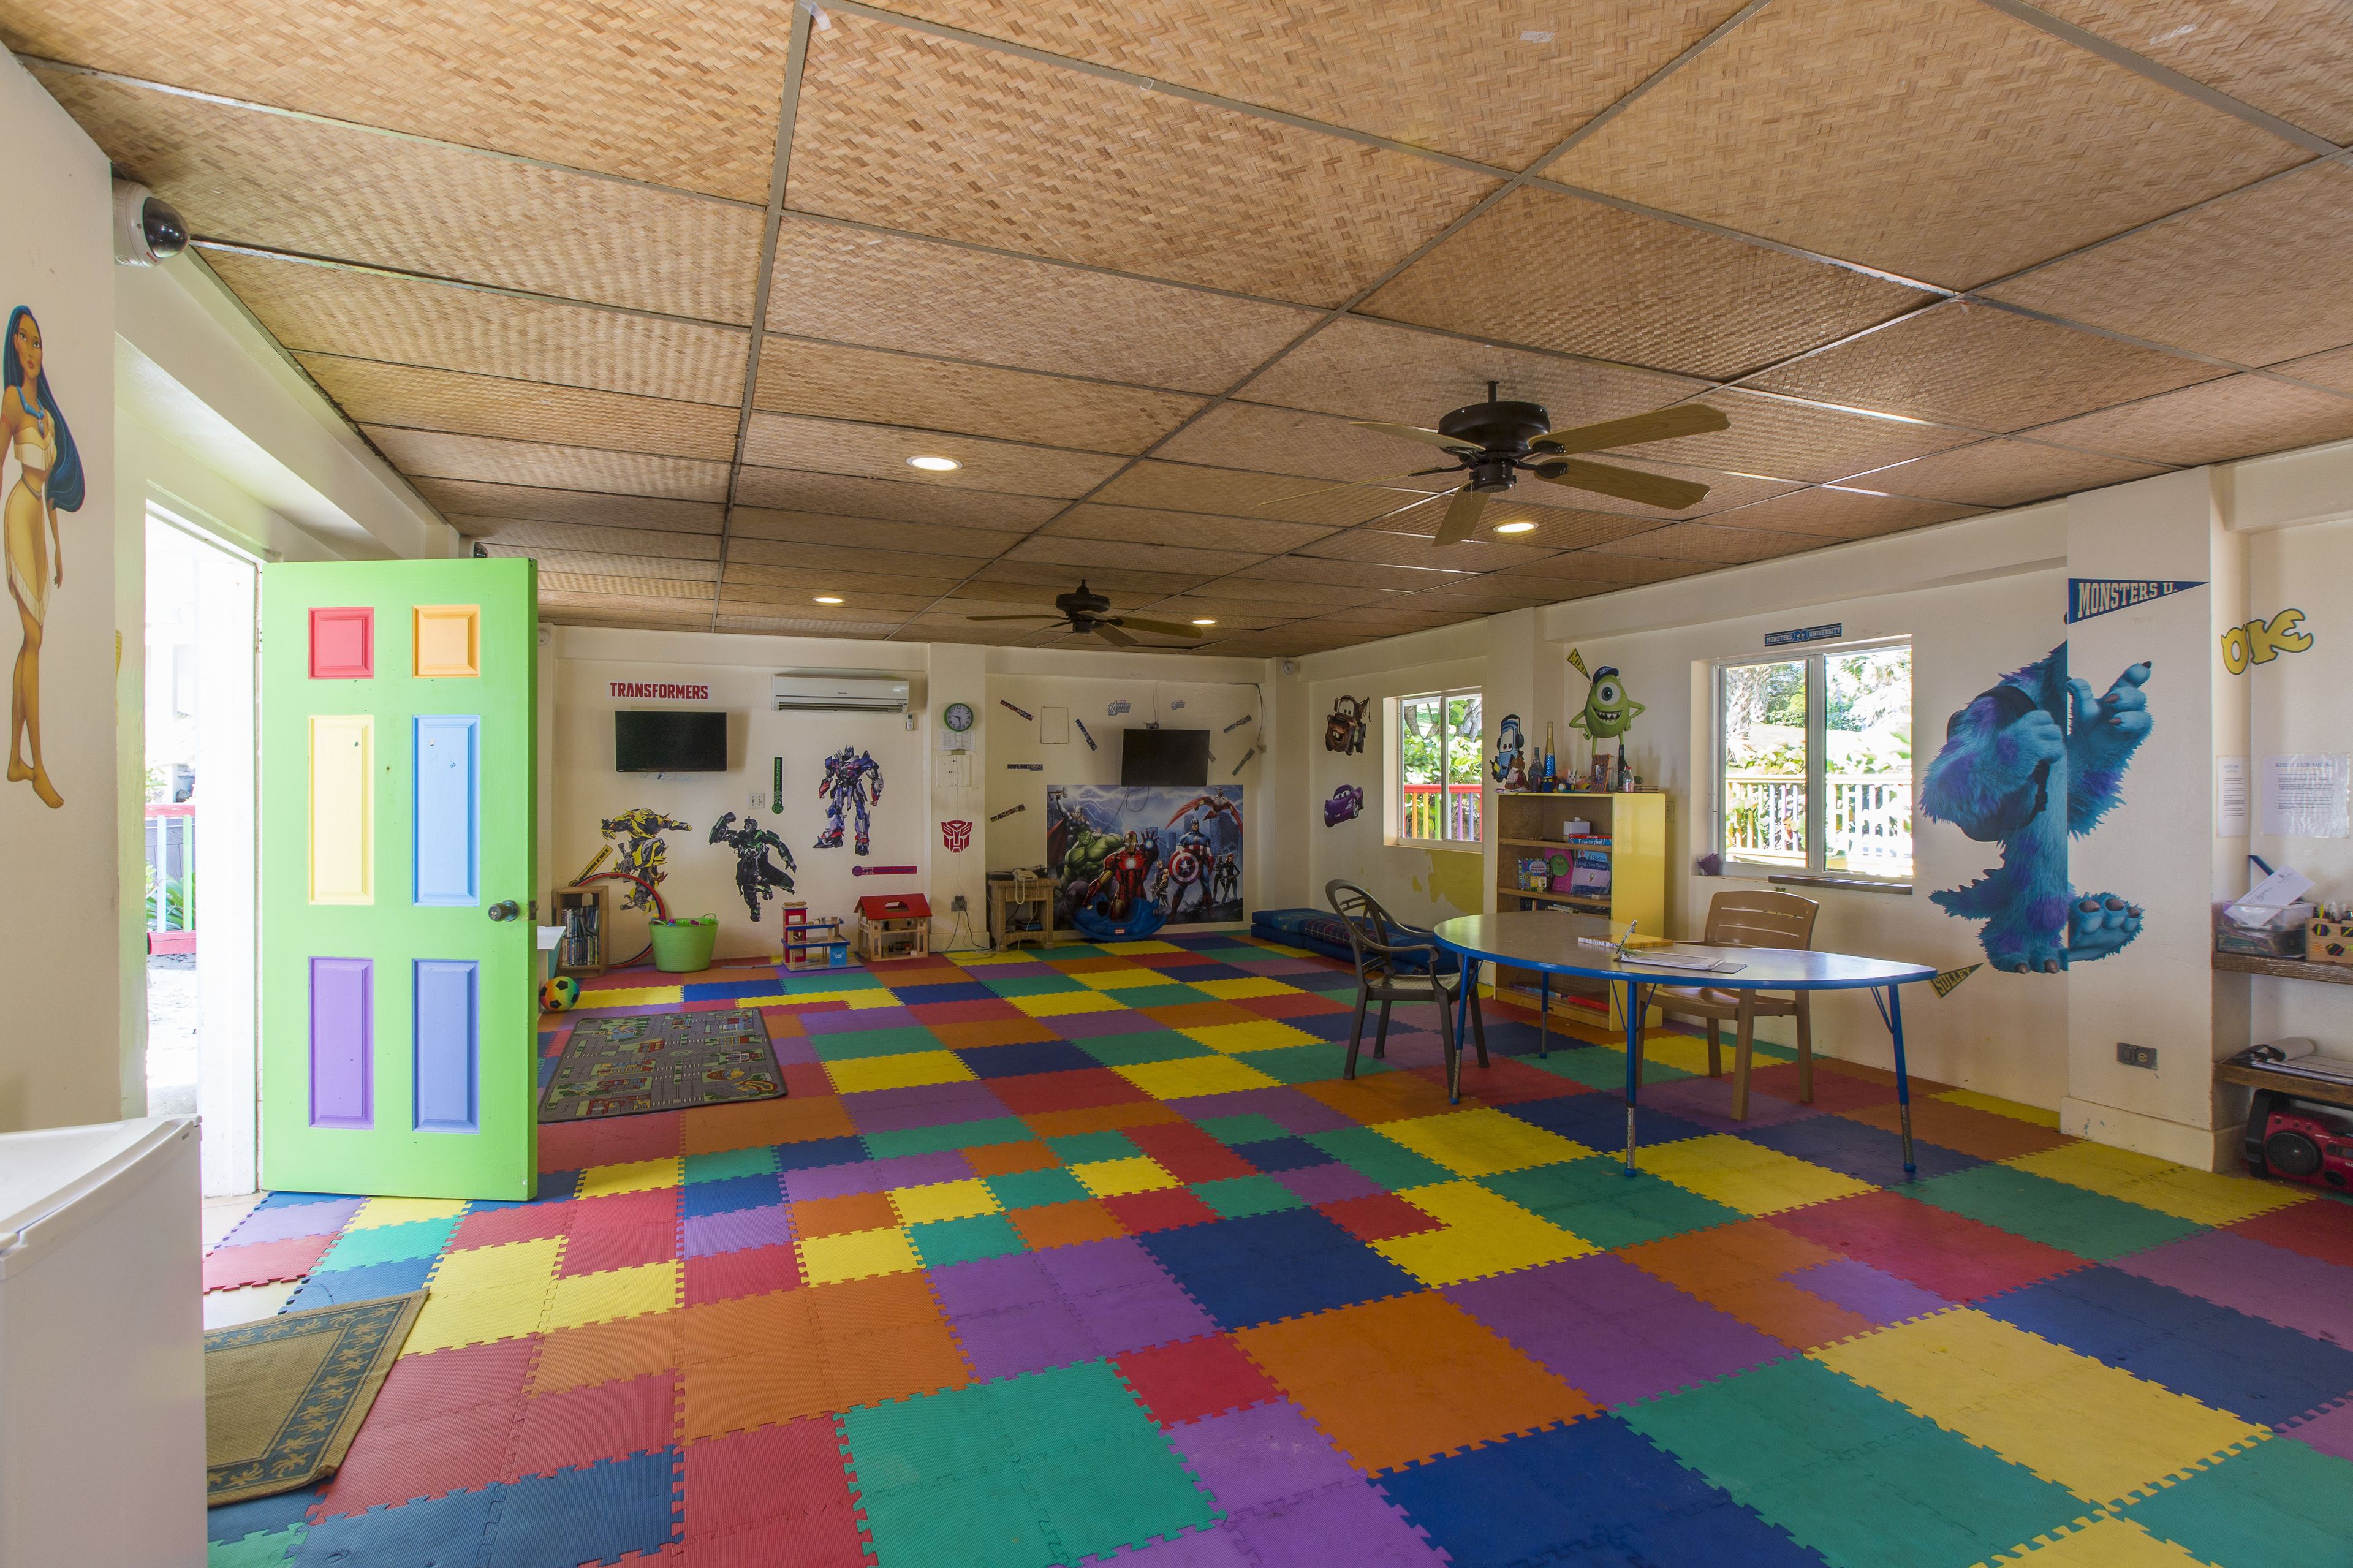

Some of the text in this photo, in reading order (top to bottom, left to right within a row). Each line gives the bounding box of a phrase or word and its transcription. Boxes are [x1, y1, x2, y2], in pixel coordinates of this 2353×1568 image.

[2077, 583, 2177, 618] MONSTERS U.
[1766, 634, 1792, 643] MONSTERS
[1809, 627, 1841, 637] UNIVERSITY
[1569, 650, 1586, 675] MIKE
[610, 682, 708, 700] TRANSFORMERS
[1934, 968, 1971, 994] SULLEY
